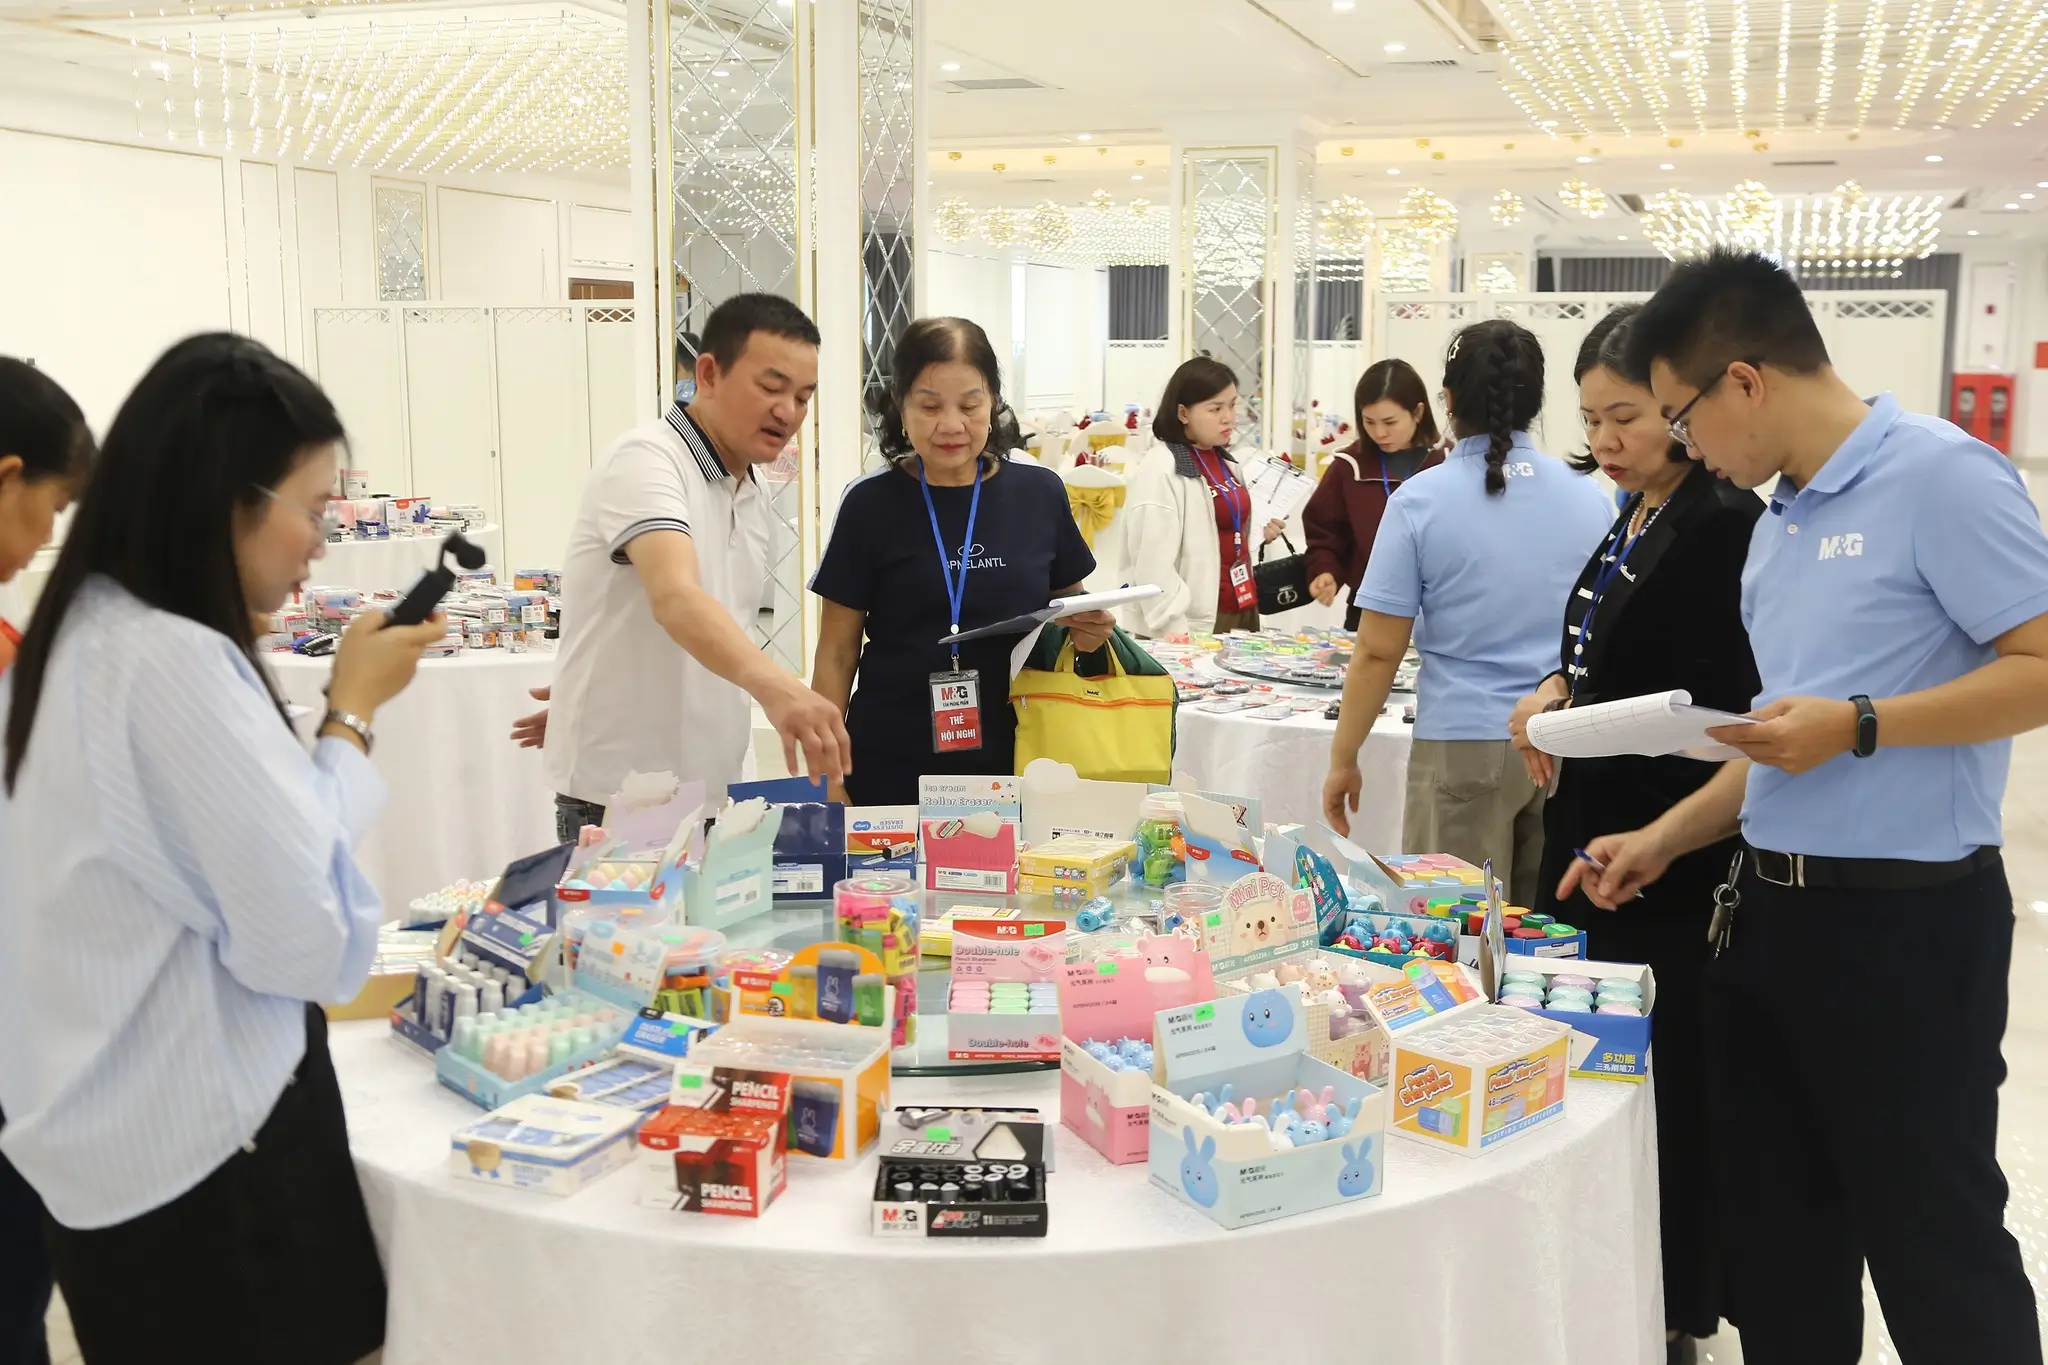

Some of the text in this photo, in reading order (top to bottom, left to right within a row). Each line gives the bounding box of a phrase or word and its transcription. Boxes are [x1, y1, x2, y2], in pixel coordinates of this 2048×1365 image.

[1818, 533, 1864, 560] M&G
[941, 686, 969, 701] M&G
[949, 712, 965, 726] THẺ
[941, 728, 976, 743] HỘI NGHỊ
[924, 784, 967, 792] Ice cream
[924, 796, 995, 807] Roller Eraser
[871, 838, 892, 846] M&G
[1228, 876, 1286, 912] Mini Pet
[996, 925, 1018, 935] M&G
[955, 945, 1020, 957] Double-hole
[968, 1038, 1030, 1048] Double-hole
[1602, 1051, 1636, 1065] 多功能
[1594, 1062, 1636, 1073] 三孔削笔刀
[1406, 1066, 1440, 1089] Pencil
[731, 1081, 780, 1099] PENCIL
[700, 1183, 753, 1200] PENCIL
[882, 1208, 917, 1222] M&G
